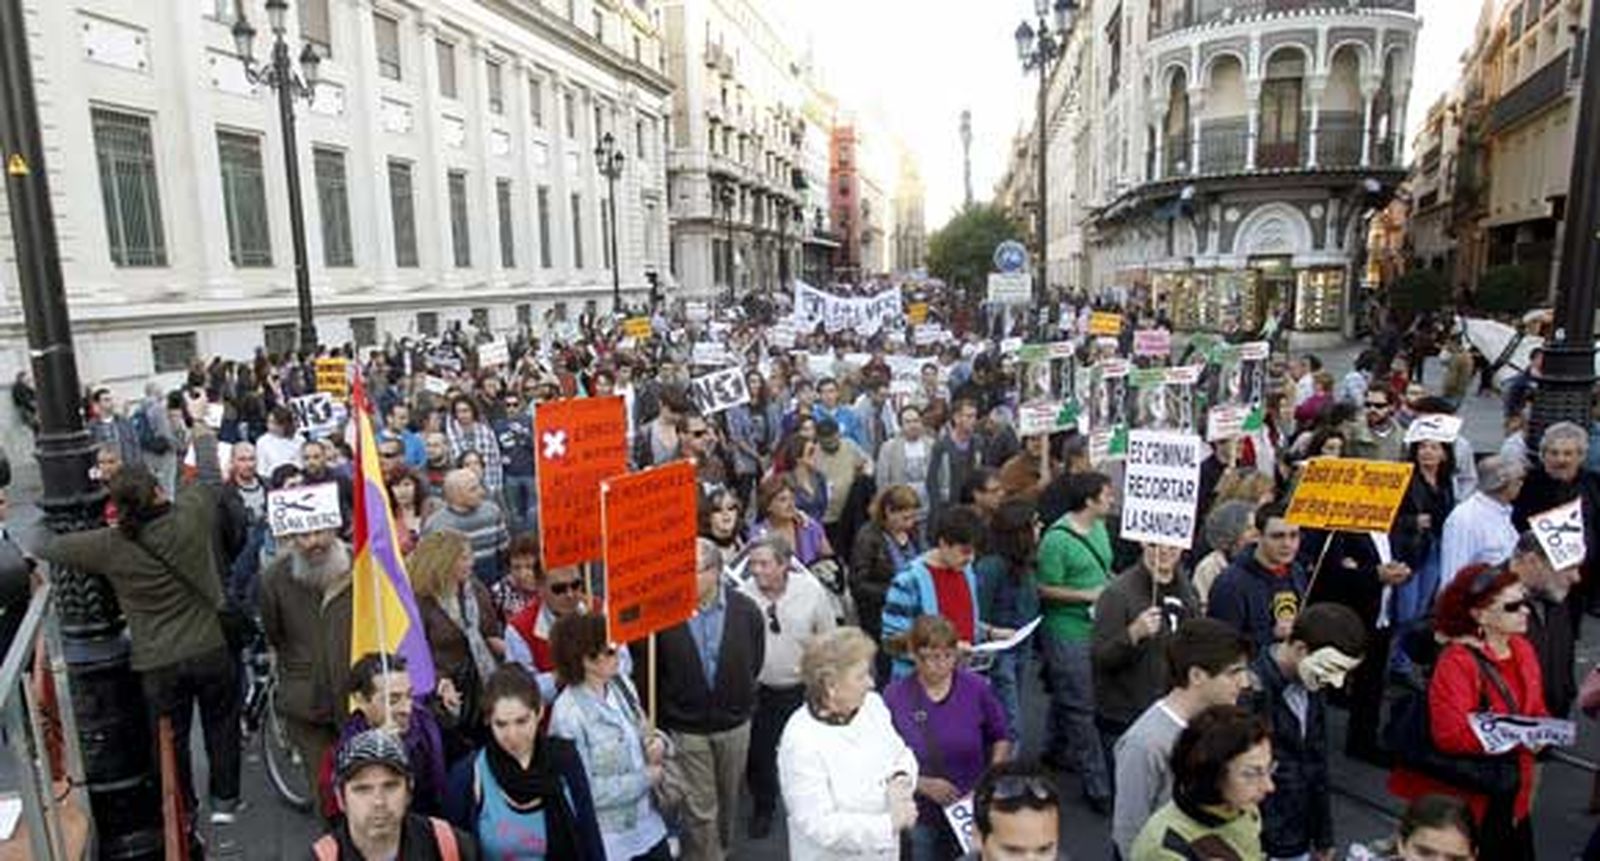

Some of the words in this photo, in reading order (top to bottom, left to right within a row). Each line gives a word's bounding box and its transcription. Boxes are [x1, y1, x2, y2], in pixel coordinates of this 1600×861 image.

[1130, 440, 1143, 464] ES
[1145, 441, 1197, 468] CRIMINAL
[1129, 473, 1196, 502] RECORTAR
[1125, 507, 1138, 532] LA
[1141, 509, 1192, 538] SANIDAD
